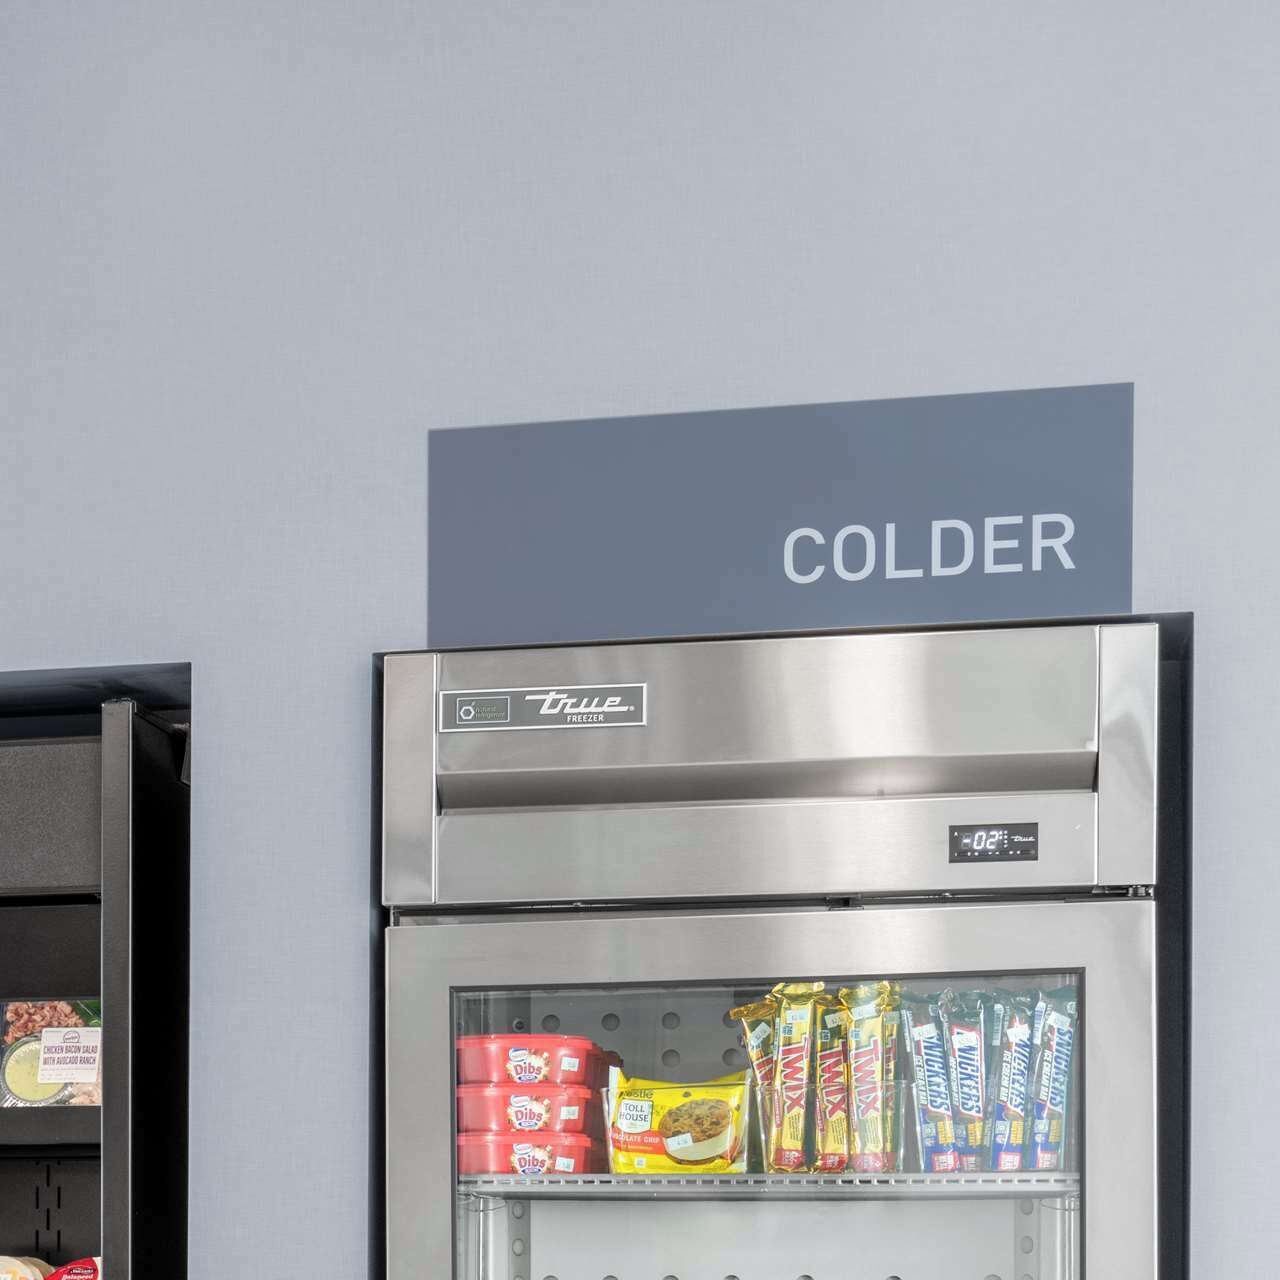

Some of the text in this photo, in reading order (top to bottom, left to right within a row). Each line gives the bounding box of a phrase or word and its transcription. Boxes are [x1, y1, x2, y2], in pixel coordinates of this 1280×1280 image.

[783, 513, 1076, 584] COLDER
[525, 691, 629, 714] true
[567, 714, 604, 723] FREEZER
[43, 1045, 97, 1054] CHICKEN BACON SALAD
[42, 1056, 95, 1065] WITH AVOCADO RANCH
[1050, 1027, 1073, 1108] SNICKERS
[513, 1061, 542, 1076] Dibs
[780, 1034, 810, 1114] TWIX
[818, 1038, 849, 1121] TWIX
[851, 1037, 881, 1119] TWIX
[514, 1107, 543, 1122] Dibs
[624, 1103, 645, 1113] TOLL
[619, 1112, 649, 1123] HOUSE
[517, 1154, 546, 1169] Dibs
